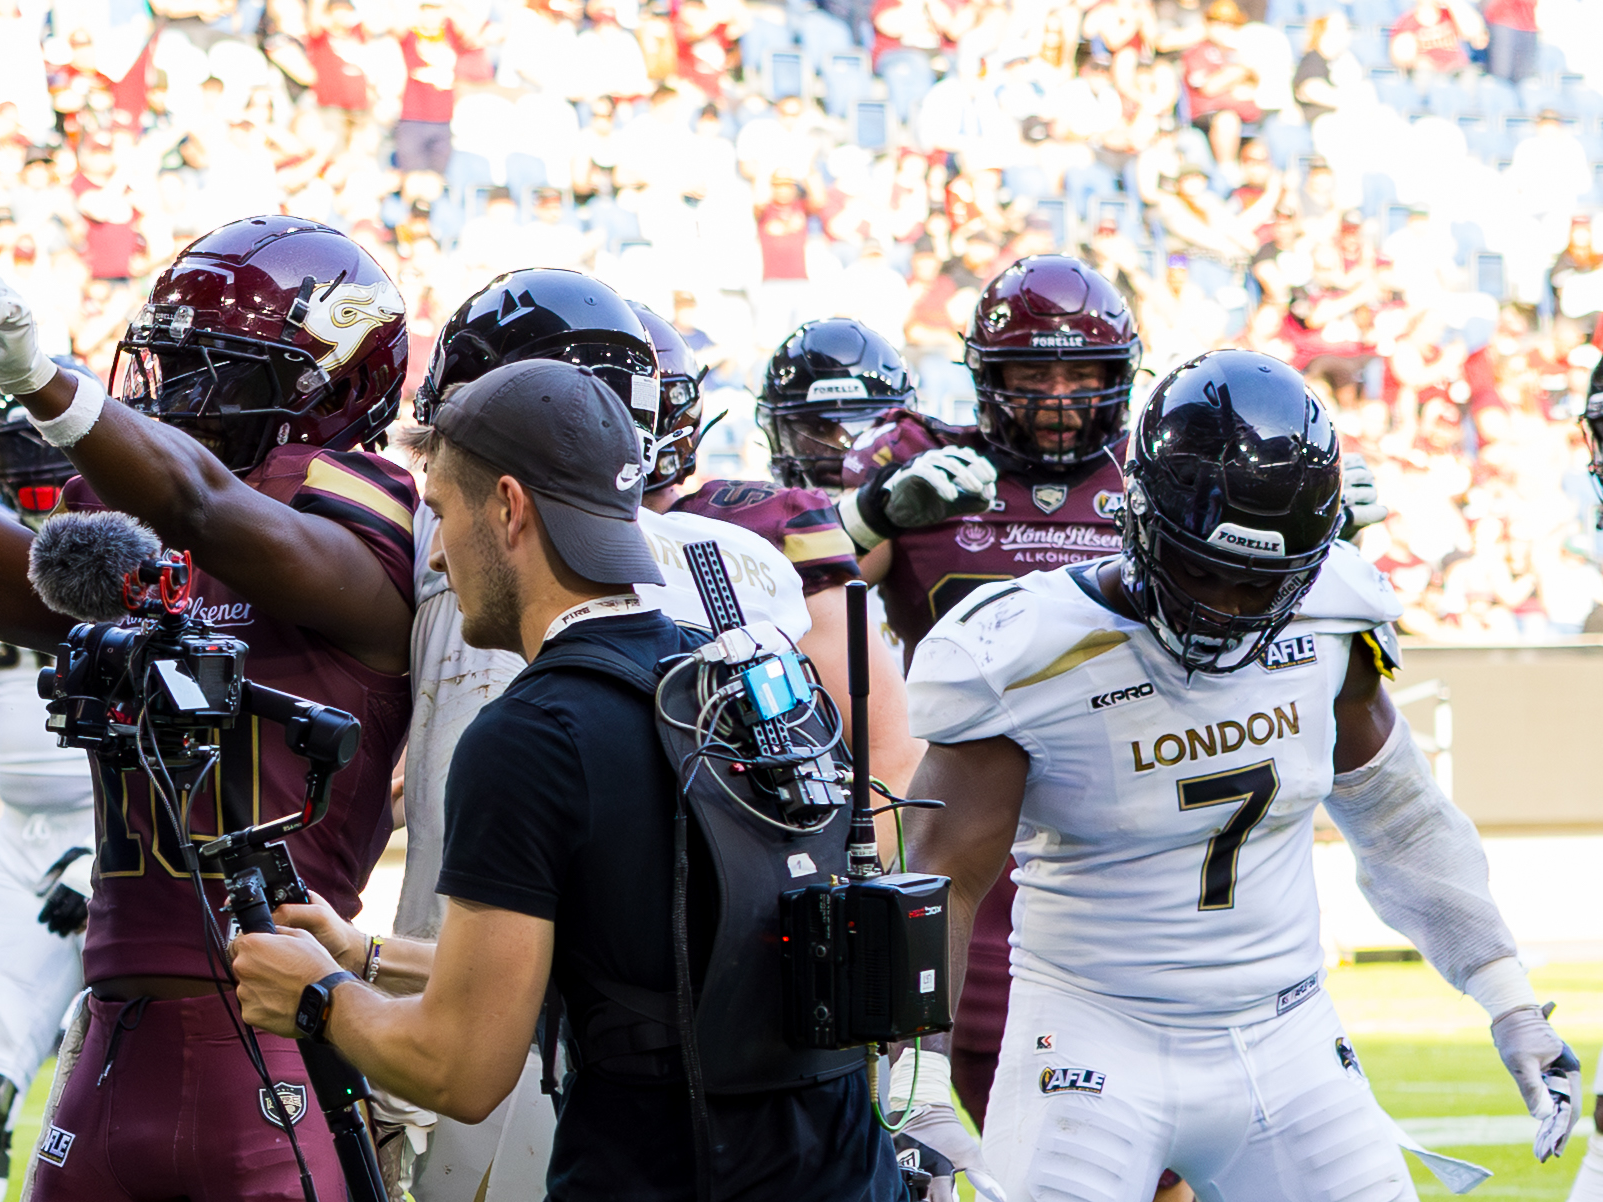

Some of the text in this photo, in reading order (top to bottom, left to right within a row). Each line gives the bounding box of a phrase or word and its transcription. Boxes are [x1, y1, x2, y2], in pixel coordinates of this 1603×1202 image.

[1032, 336, 1084, 348] FORELLE
[1217, 530, 1281, 553] FORELLE
[1266, 633, 1314, 666] AFLE
[1130, 700, 1301, 773] LONDON
[1175, 757, 1282, 912] 7
[1045, 1068, 1106, 1090] AFLE
